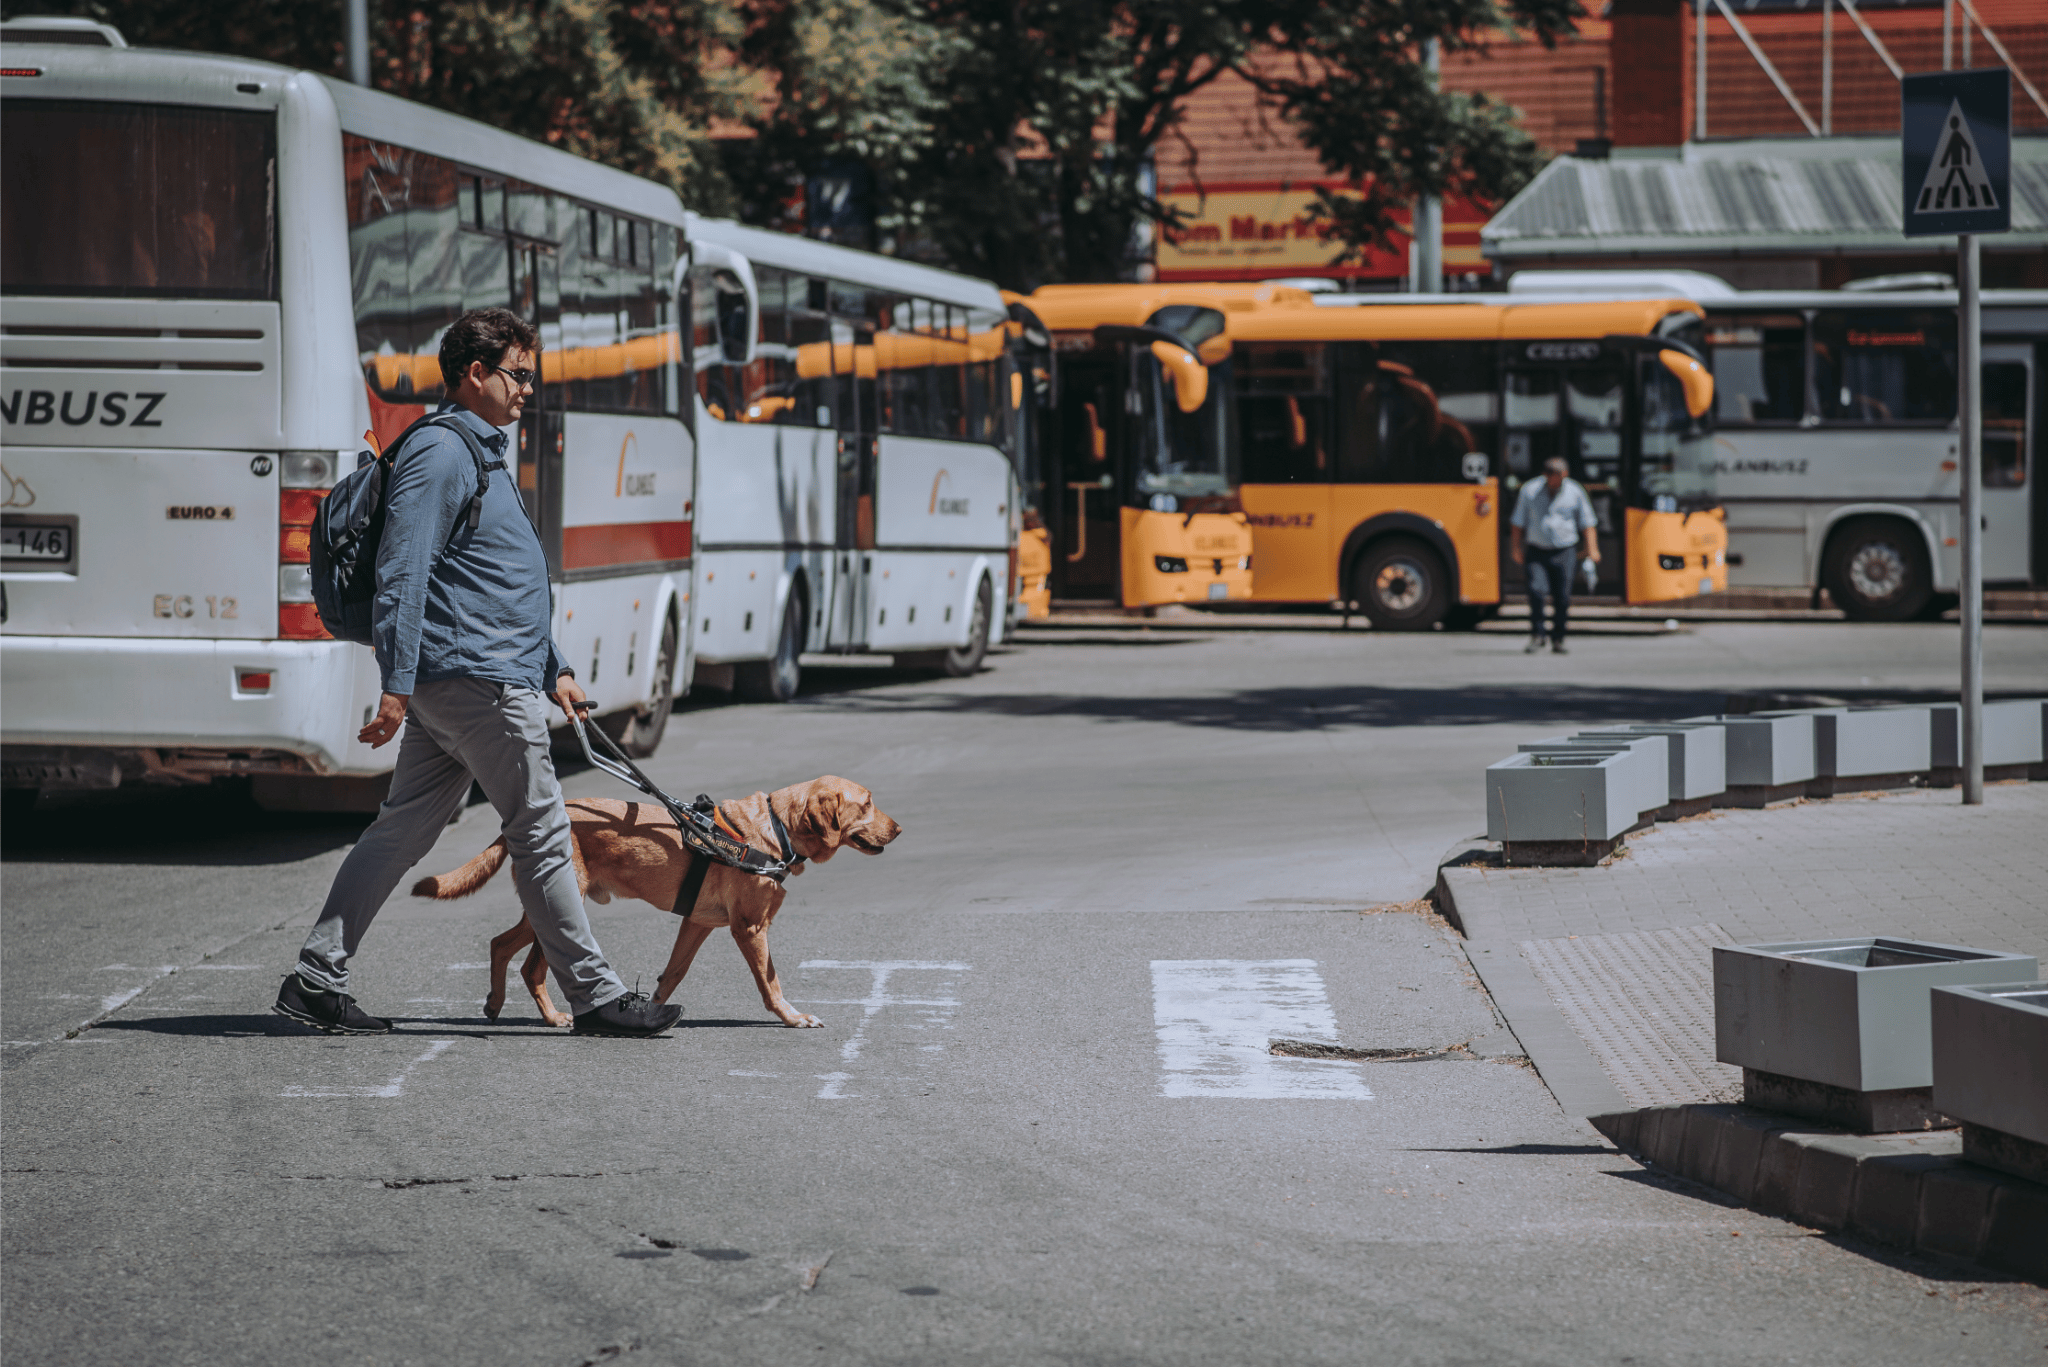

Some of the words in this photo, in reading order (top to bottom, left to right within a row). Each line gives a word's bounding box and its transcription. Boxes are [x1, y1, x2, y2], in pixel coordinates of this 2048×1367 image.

[0, 389, 167, 427] NBUSZ
[168, 506, 216, 520] EURO
[220, 506, 232, 520] 4
[154, 594, 195, 618] EC
[206, 596, 239, 619] 12
